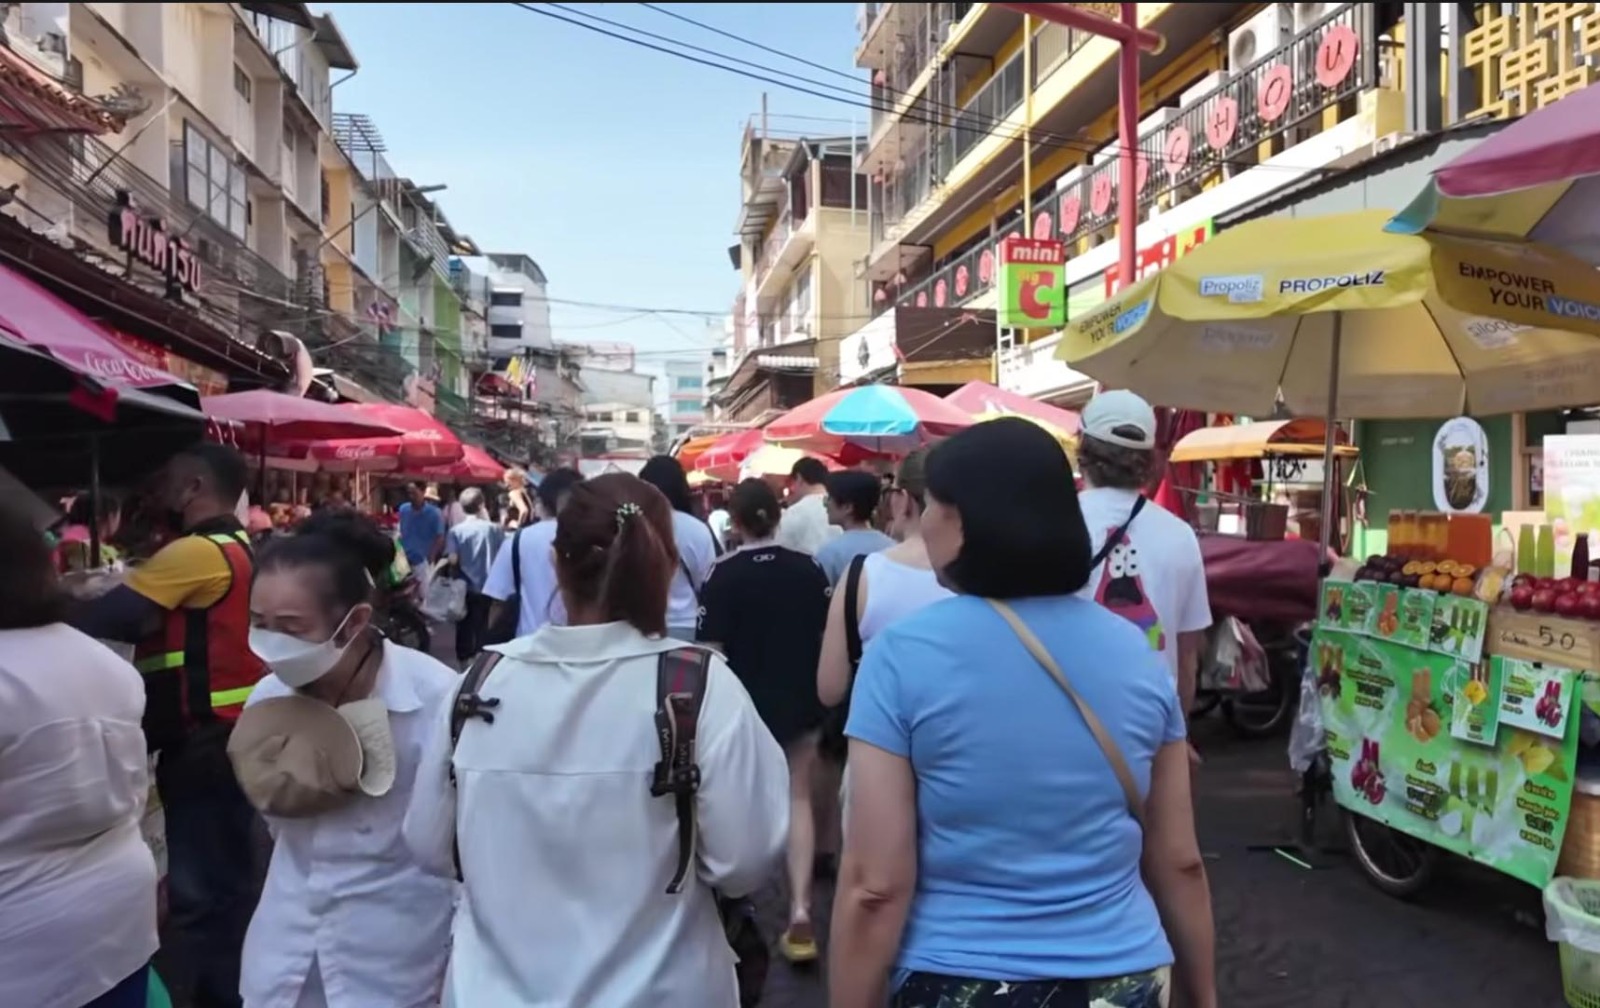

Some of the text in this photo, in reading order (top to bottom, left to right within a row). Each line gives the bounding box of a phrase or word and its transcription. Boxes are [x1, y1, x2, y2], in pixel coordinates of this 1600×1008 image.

[1012, 242, 1061, 262] mini
[1204, 280, 1259, 296] Propoliz
[1280, 270, 1384, 294] PROPOLIZ
[1459, 262, 1555, 294] EMPOWER
[1490, 287, 1545, 310] YOUR
